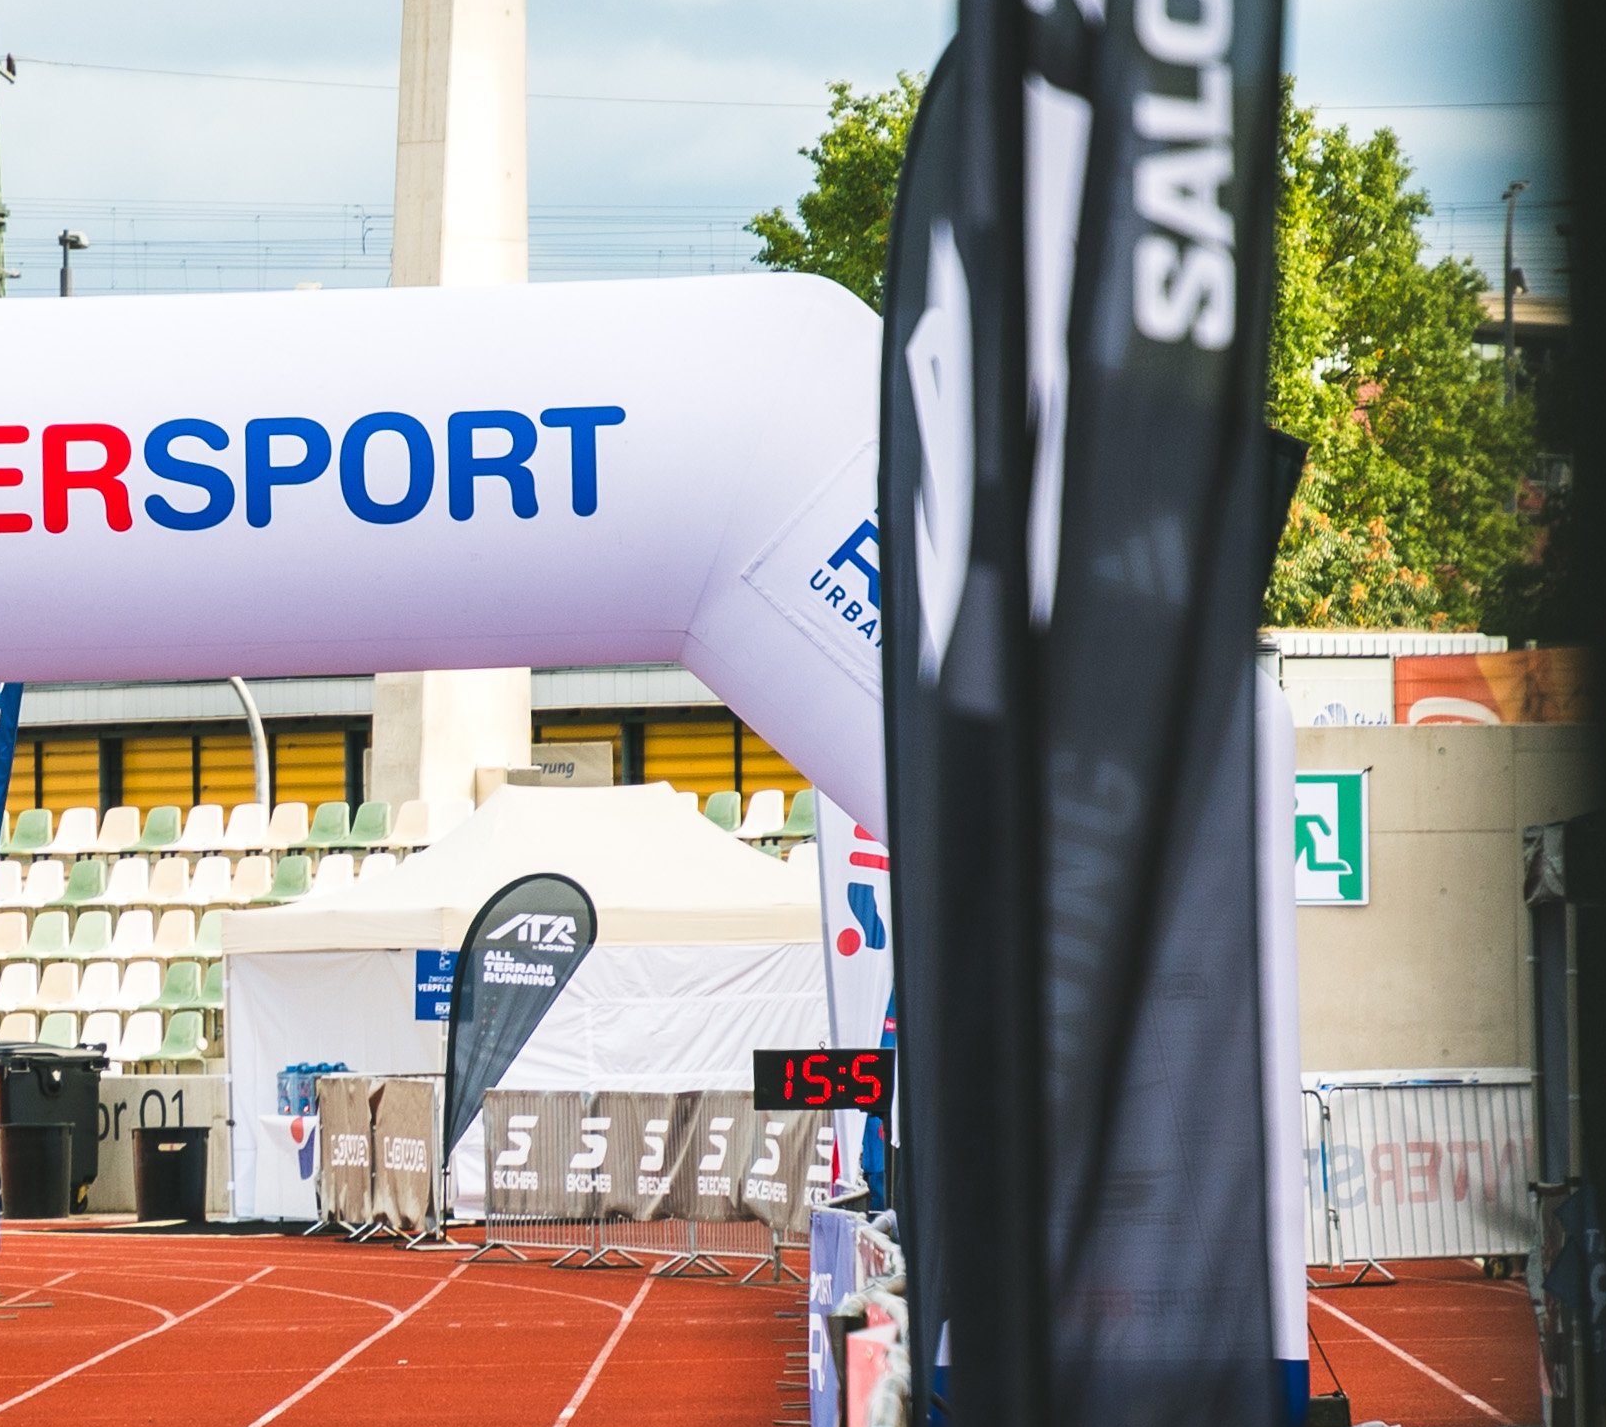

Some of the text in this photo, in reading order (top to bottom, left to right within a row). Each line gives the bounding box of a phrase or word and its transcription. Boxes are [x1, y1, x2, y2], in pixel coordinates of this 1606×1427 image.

[483, 950, 515, 962] ALL
[483, 961, 554, 975] TERRAIN
[483, 972, 556, 987] RUNNING
[782, 1053, 882, 1105] 15:5
[384, 1135, 427, 1173] LOWA
